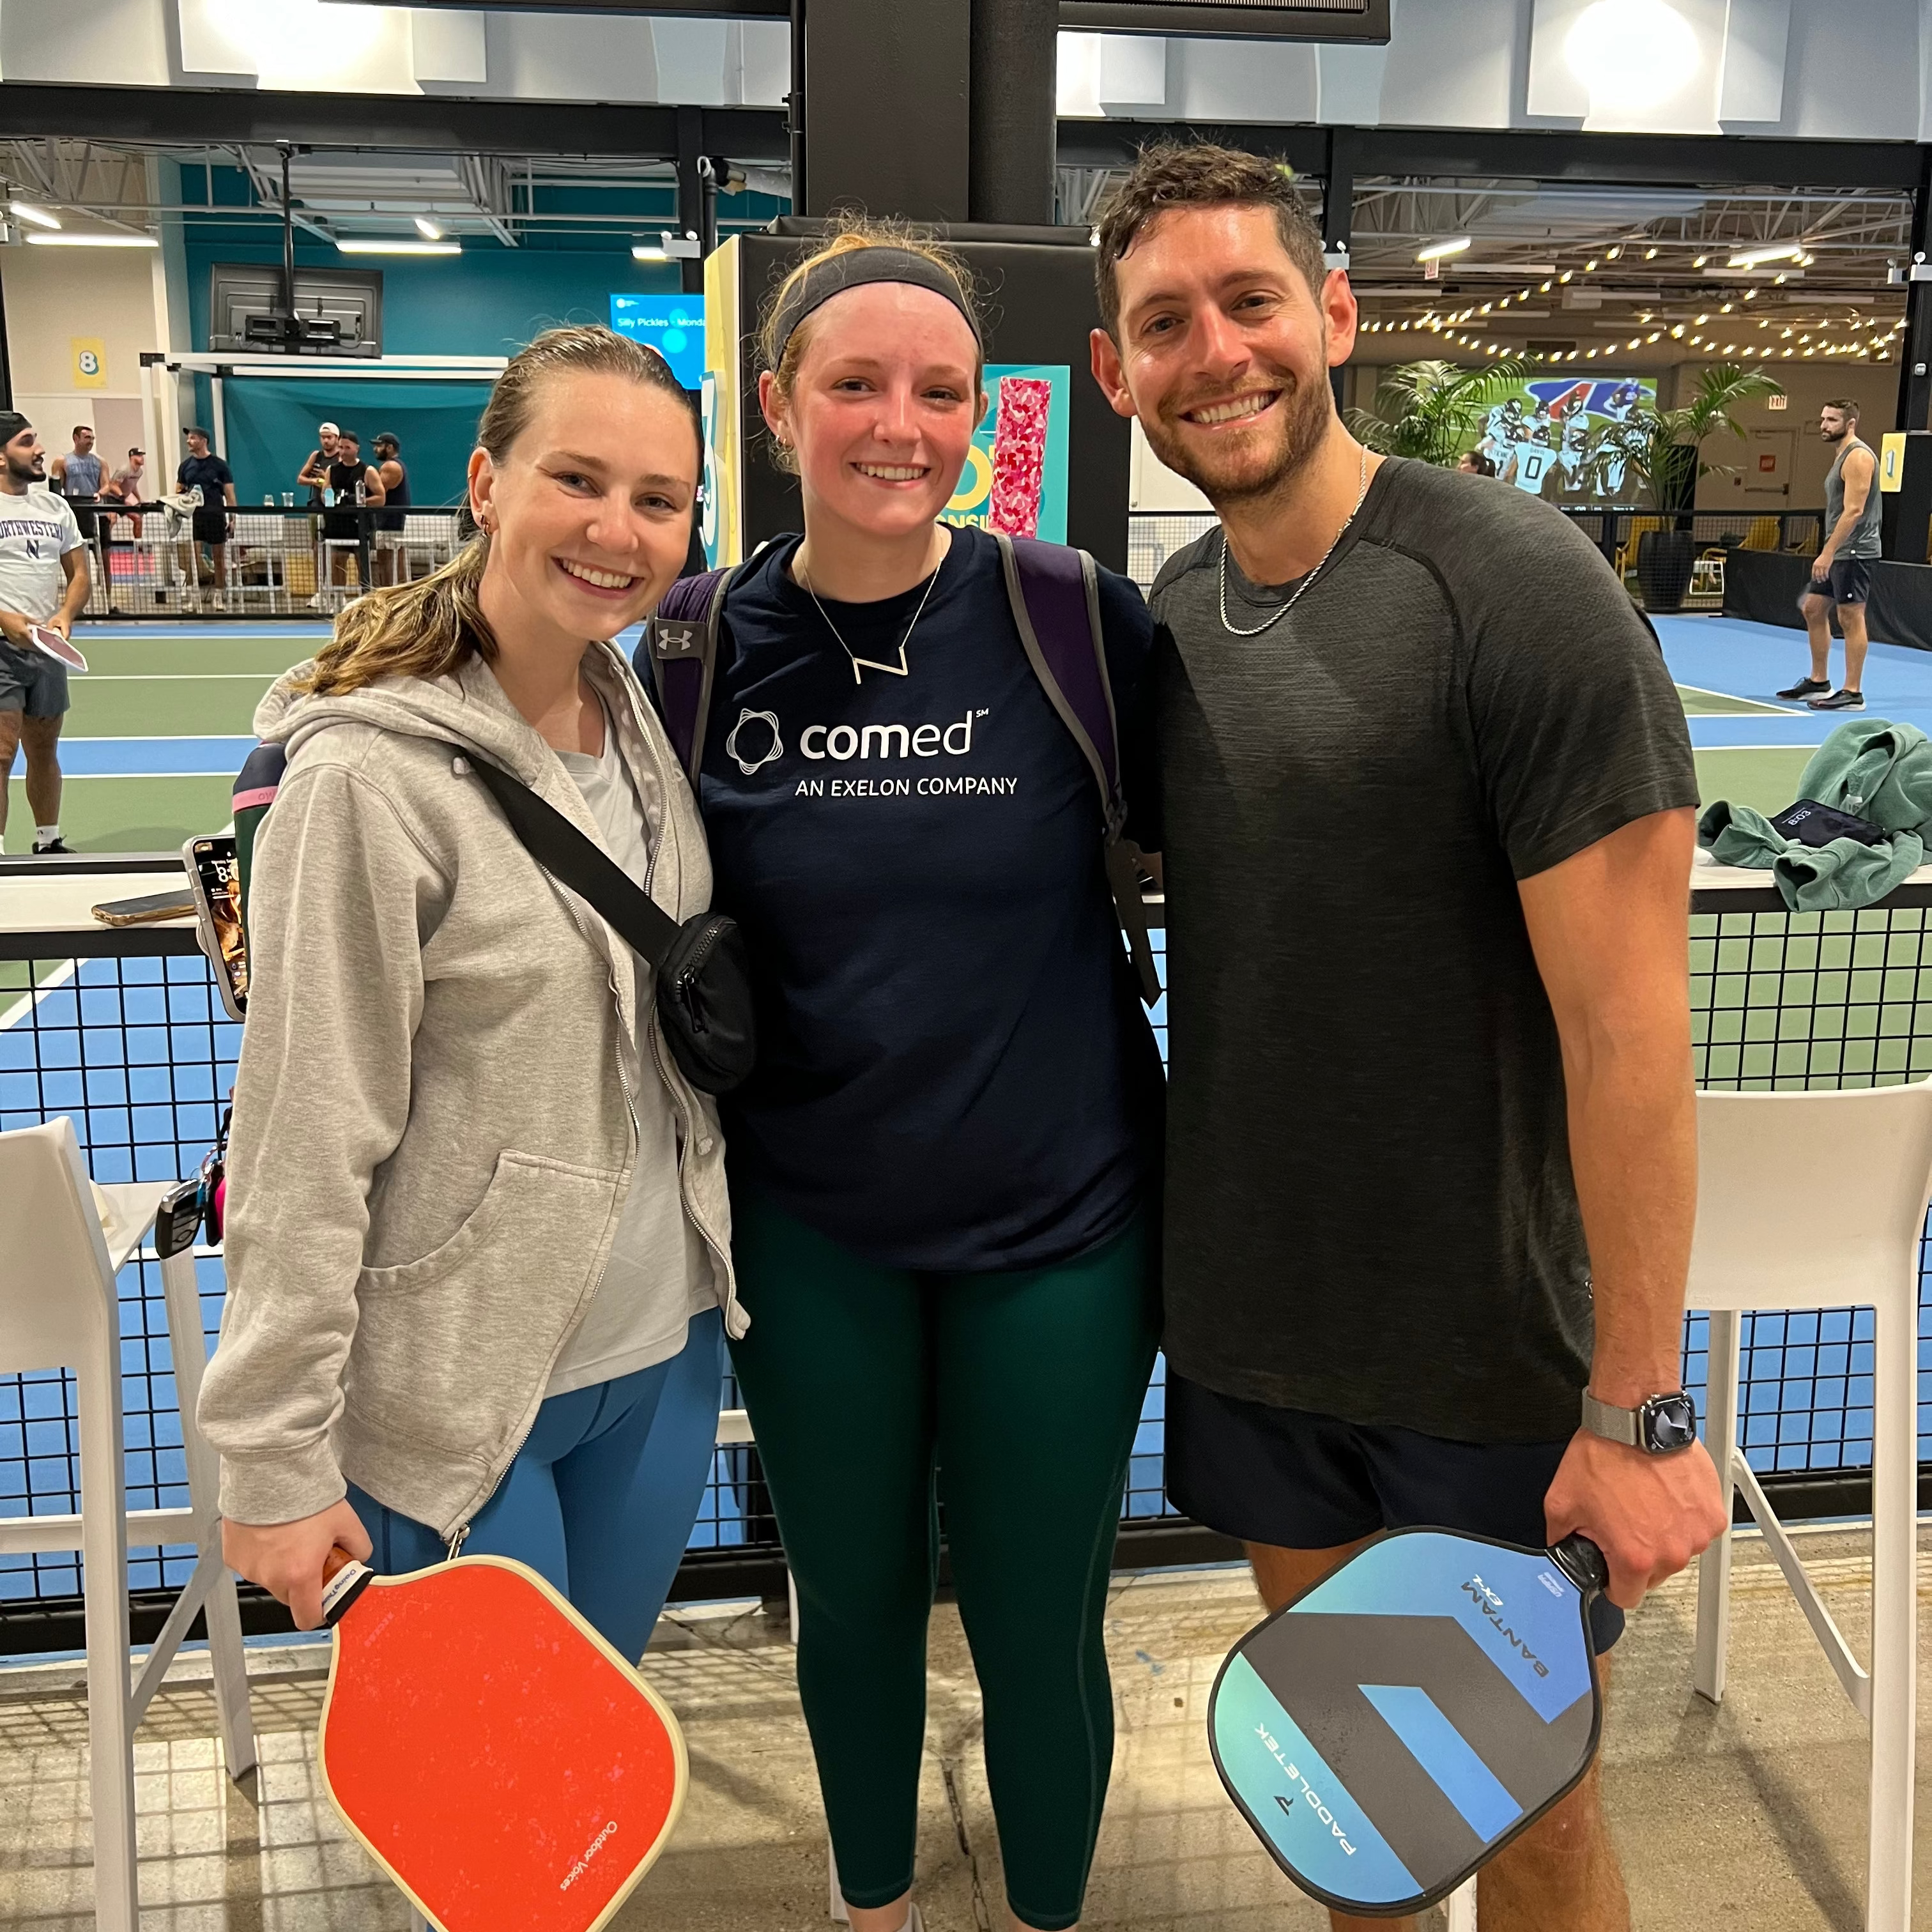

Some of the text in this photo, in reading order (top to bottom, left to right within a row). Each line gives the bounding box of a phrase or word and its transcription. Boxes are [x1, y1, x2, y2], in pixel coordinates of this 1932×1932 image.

[617, 318, 635, 328] Silly
[638, 318, 669, 327] Pickles
[79, 351, 98, 375] 8
[1524, 456, 1542, 480] 0
[1886, 450, 1894, 478] 1
[26, 539, 40, 560] N
[800, 710, 972, 760] comed
[795, 778, 1017, 797] AN EXELON COMPANY
[1788, 810, 1811, 825] 8:03
[1472, 1574, 1503, 1606] EX-L
[1461, 1581, 1549, 1678] BANTAM
[1255, 1722, 1356, 1855] PADDLETEK
[560, 1821, 618, 1891] Outdoor Voices
